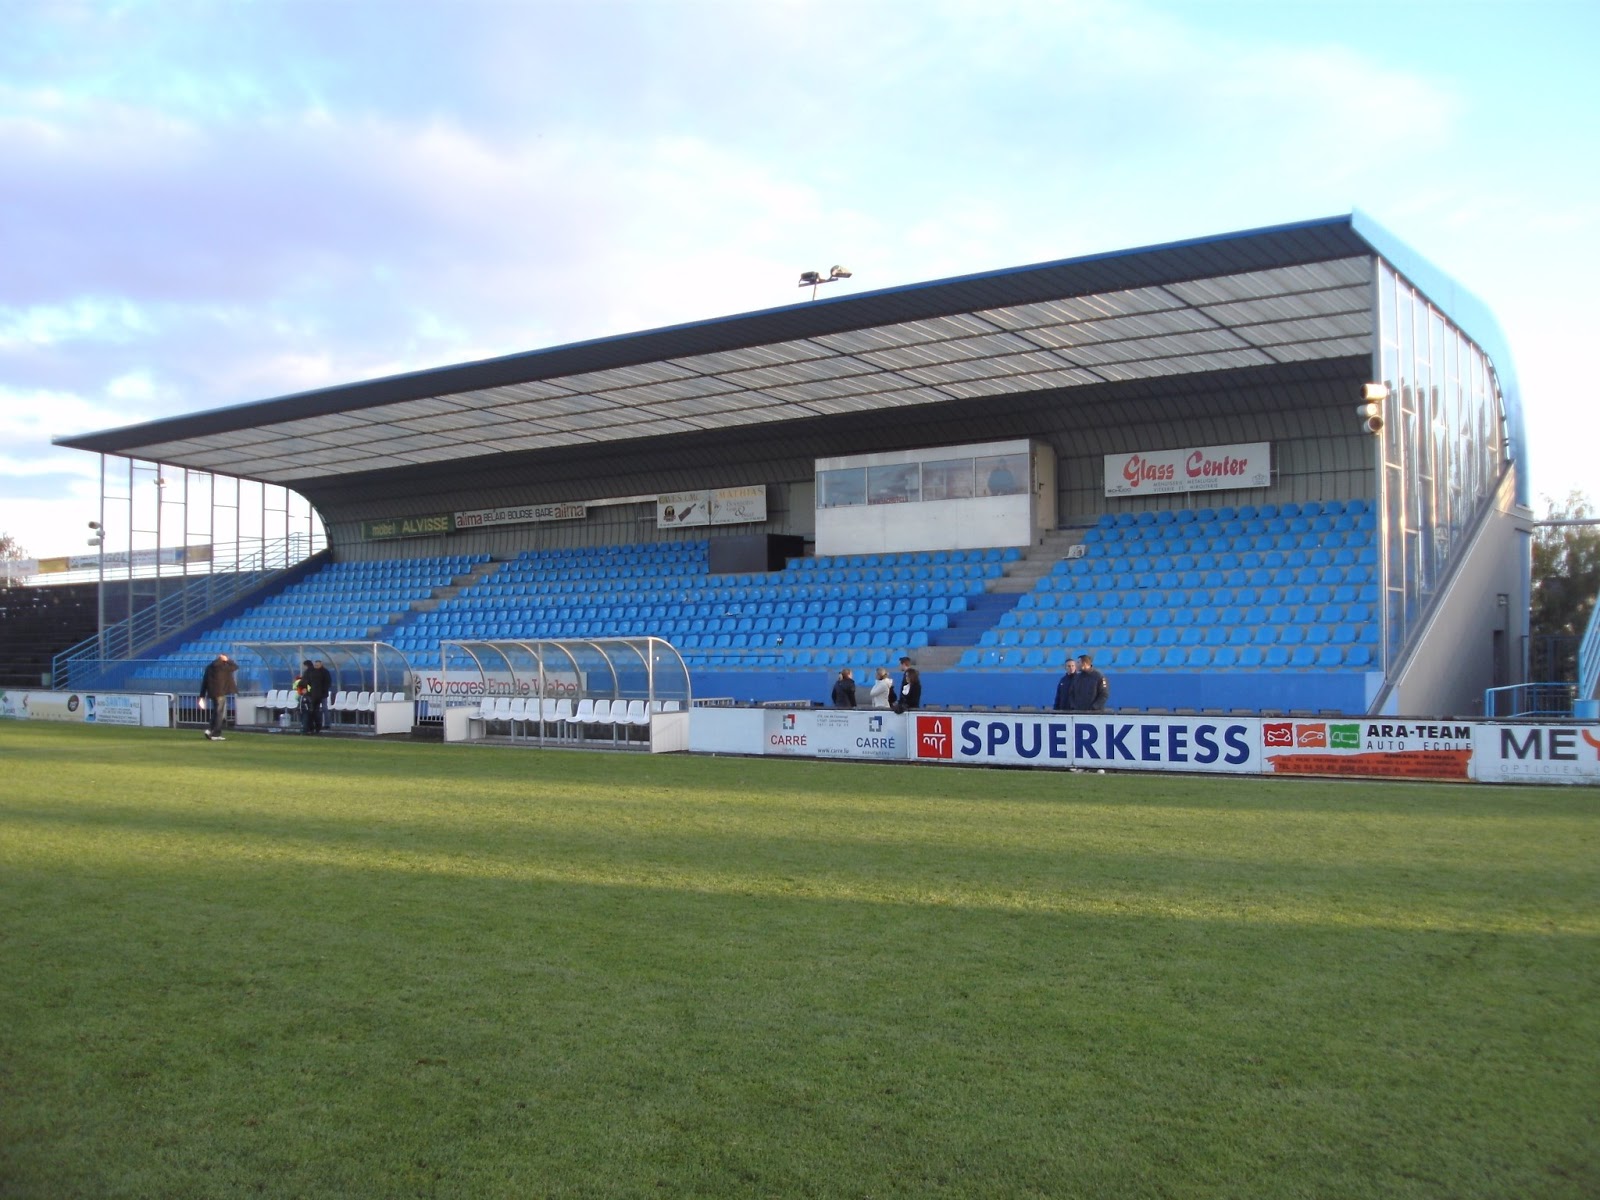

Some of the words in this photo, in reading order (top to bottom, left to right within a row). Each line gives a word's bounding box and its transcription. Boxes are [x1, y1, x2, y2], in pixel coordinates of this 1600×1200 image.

[1123, 454, 1174, 487] Glass
[1186, 450, 1247, 478] Center
[456, 512, 483, 527] alima
[554, 503, 584, 518] alima
[402, 516, 449, 533] ALVISSE
[770, 732, 807, 746] CARRÉ
[1367, 723, 1471, 740] ARA-TEAM
[856, 736, 895, 749] CARRÉ
[960, 719, 1250, 765] SPUERKEESS
[1367, 740, 1405, 751] AUTO
[1423, 741, 1473, 752] ECOLE
[1500, 764, 1582, 774] OPTICIEN
